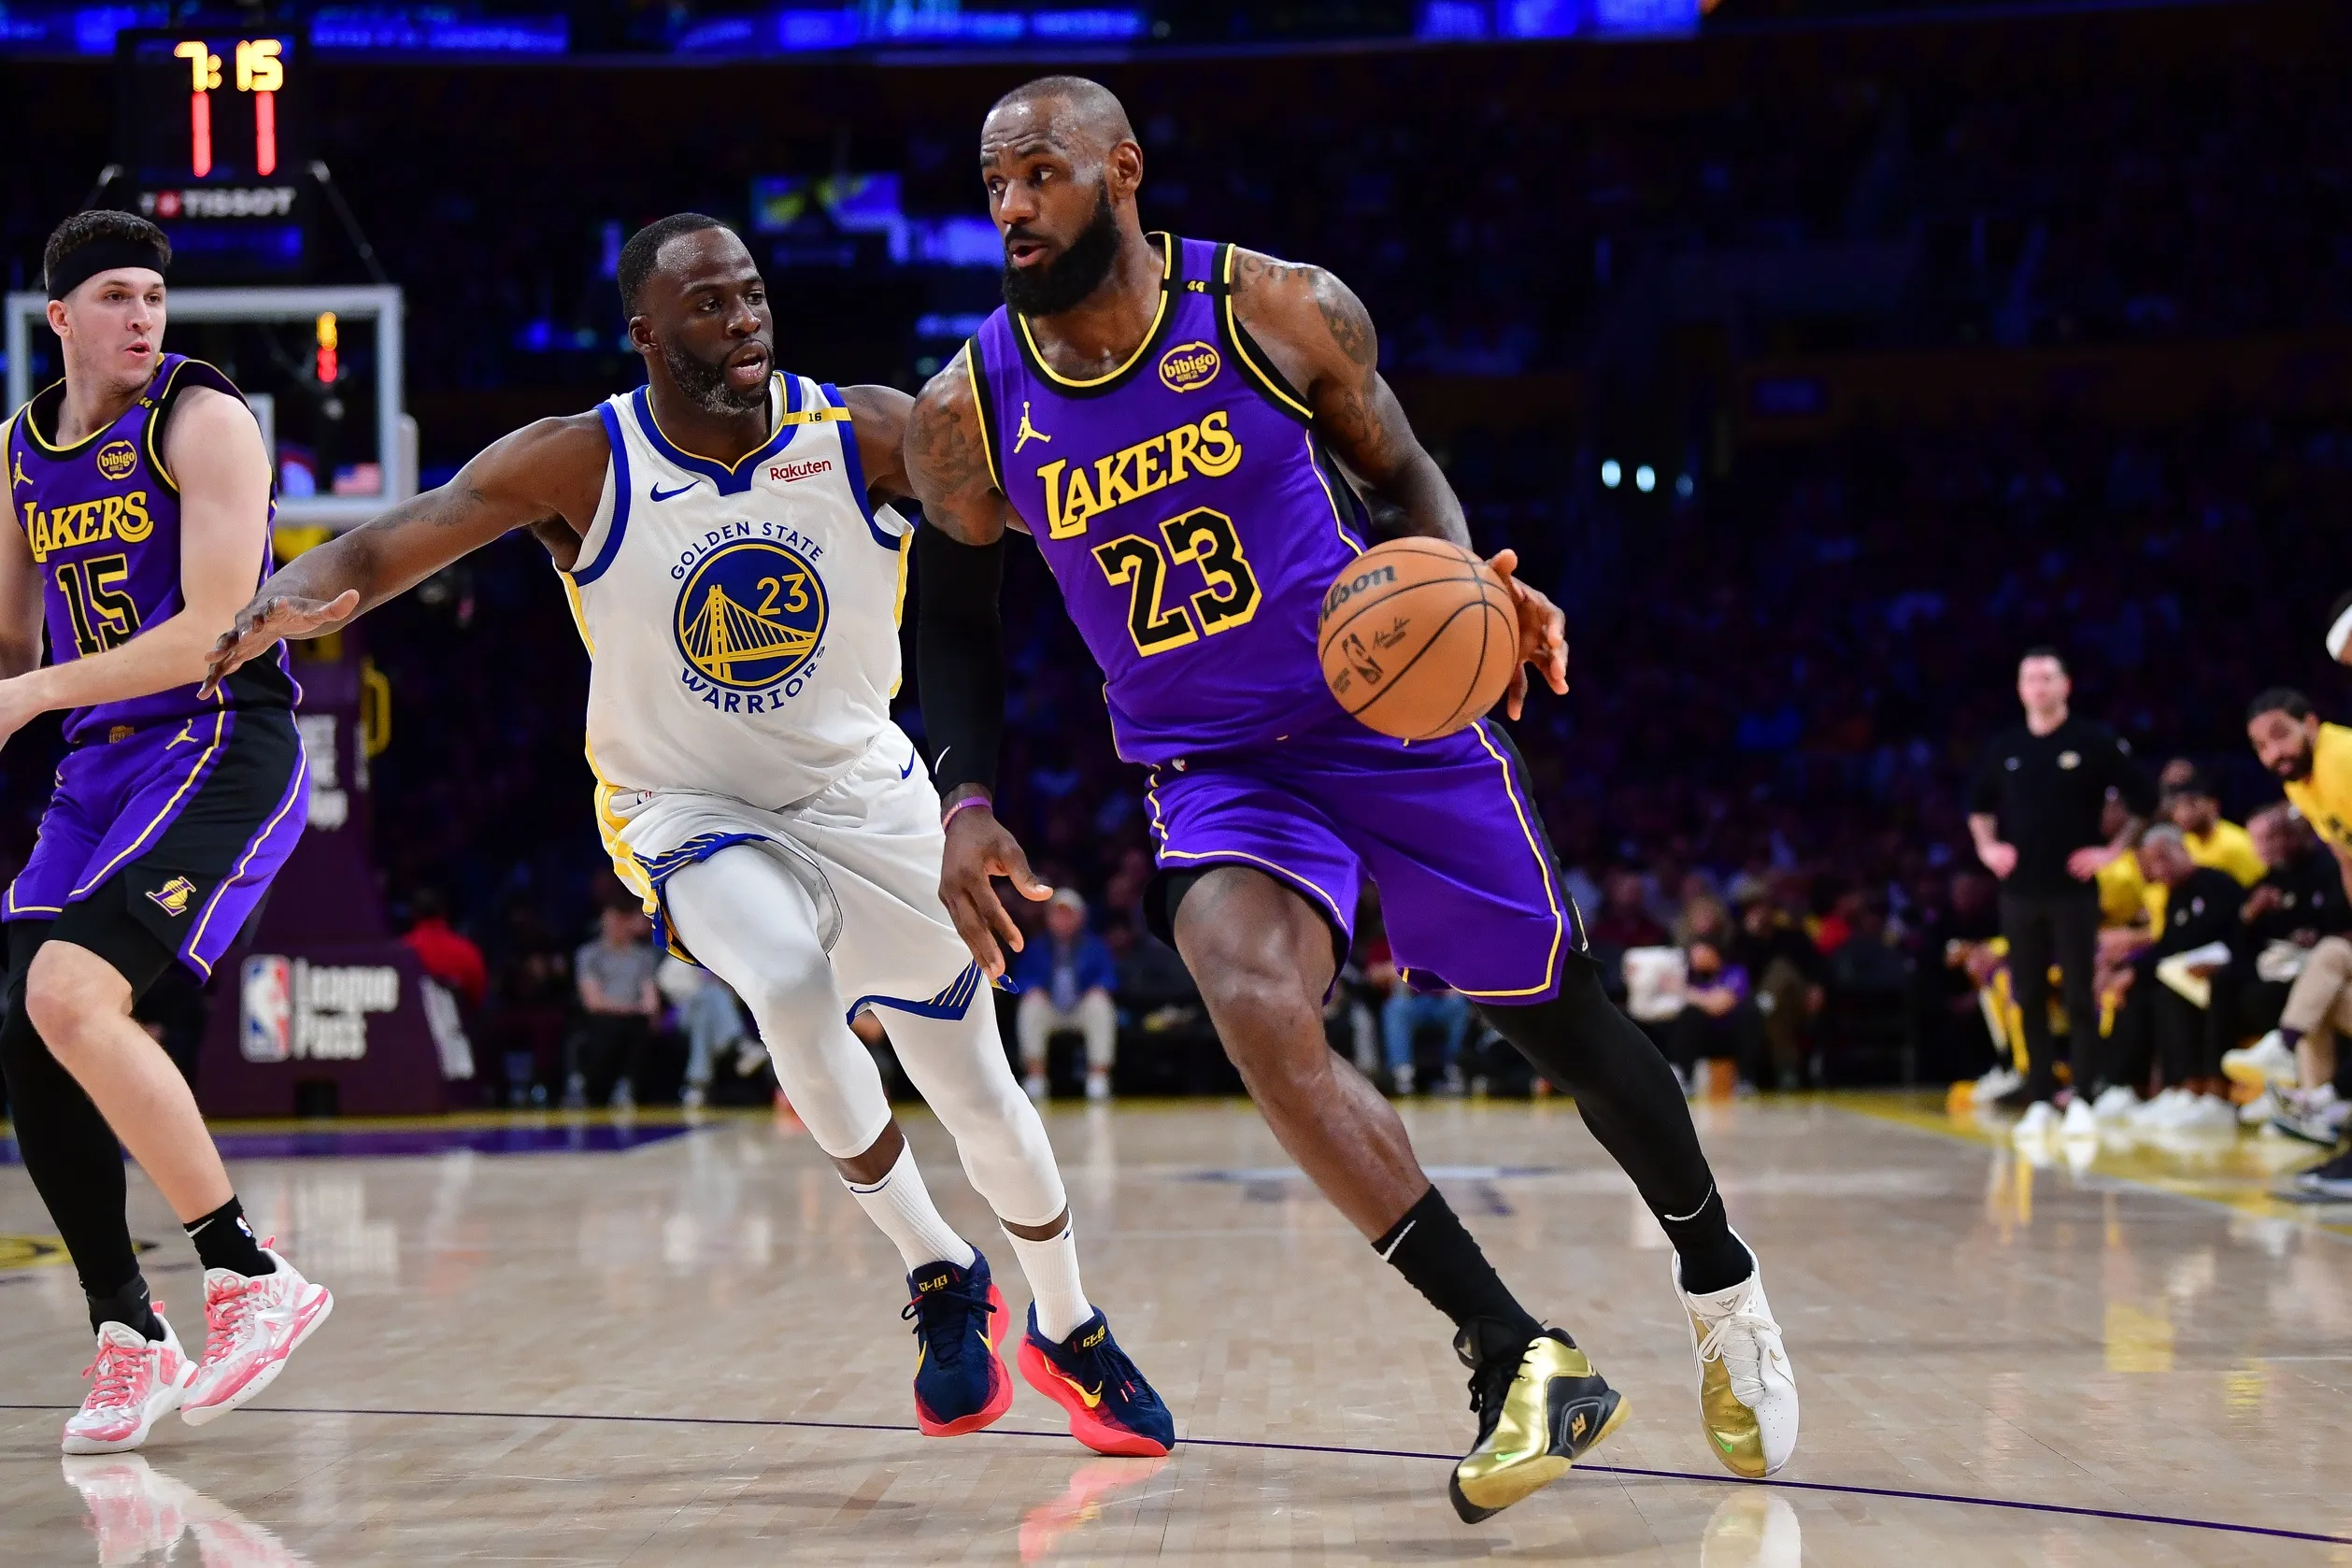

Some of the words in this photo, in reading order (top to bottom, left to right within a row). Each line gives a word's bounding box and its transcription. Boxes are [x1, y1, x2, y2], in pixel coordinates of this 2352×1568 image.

[182, 188, 296, 217] TISSOT
[1187, 280, 1205, 292] 44
[1163, 354, 1216, 378] bibigo
[808, 412, 822, 421] 16
[101, 450, 135, 467] bibigo
[769, 460, 832, 482] Rakuten
[1036, 410, 1243, 540] LAKERS
[23, 491, 154, 563] LAKERS
[670, 520, 751, 580] GOLDEN
[762, 521, 824, 562] STATE
[55, 553, 141, 660] 15
[756, 572, 808, 617] 23
[1090, 506, 1263, 658] 23
[1318, 565, 1397, 635] ilson
[681, 645, 826, 714] WARRIORS
[294, 957, 400, 1014] League
[294, 1006, 366, 1060] Pass
